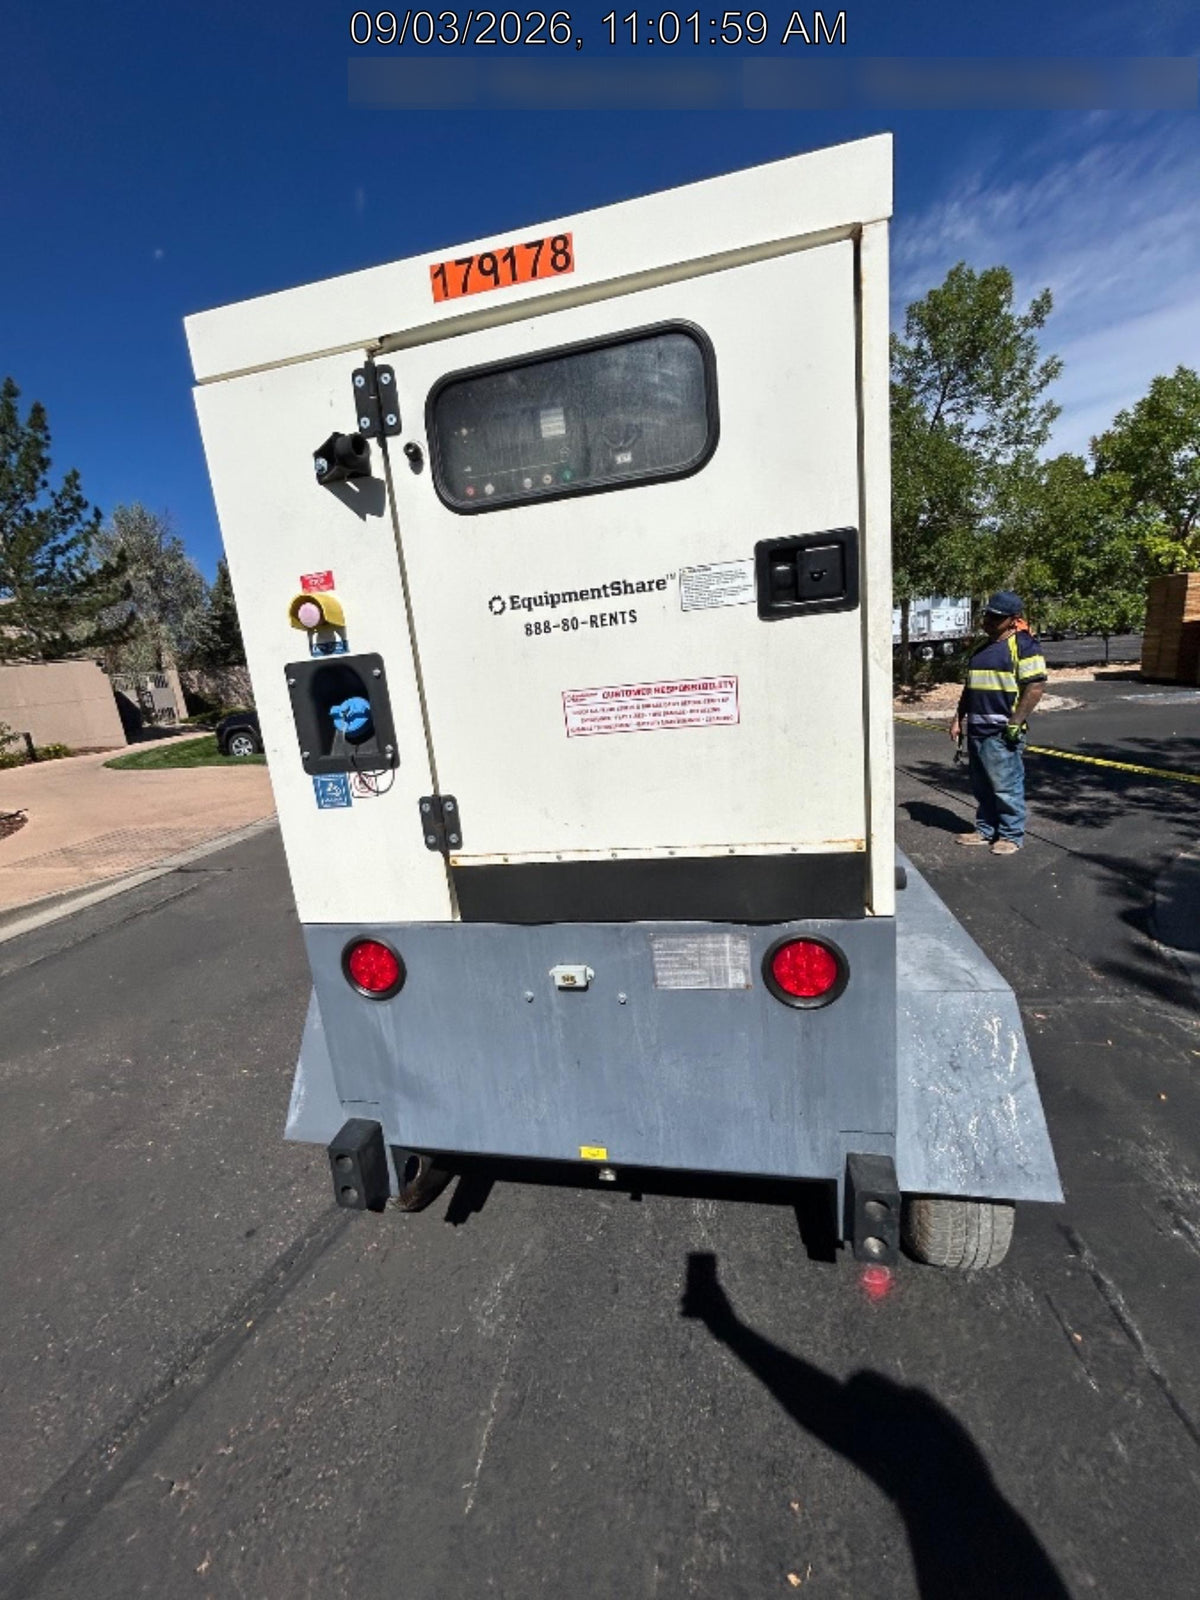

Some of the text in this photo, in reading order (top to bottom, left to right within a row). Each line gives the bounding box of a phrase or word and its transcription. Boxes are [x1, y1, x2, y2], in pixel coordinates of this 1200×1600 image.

[432, 234, 572, 298] 179178
[508, 577, 668, 612] EquipmentShare
[523, 609, 638, 637] 888-80-RENTS
